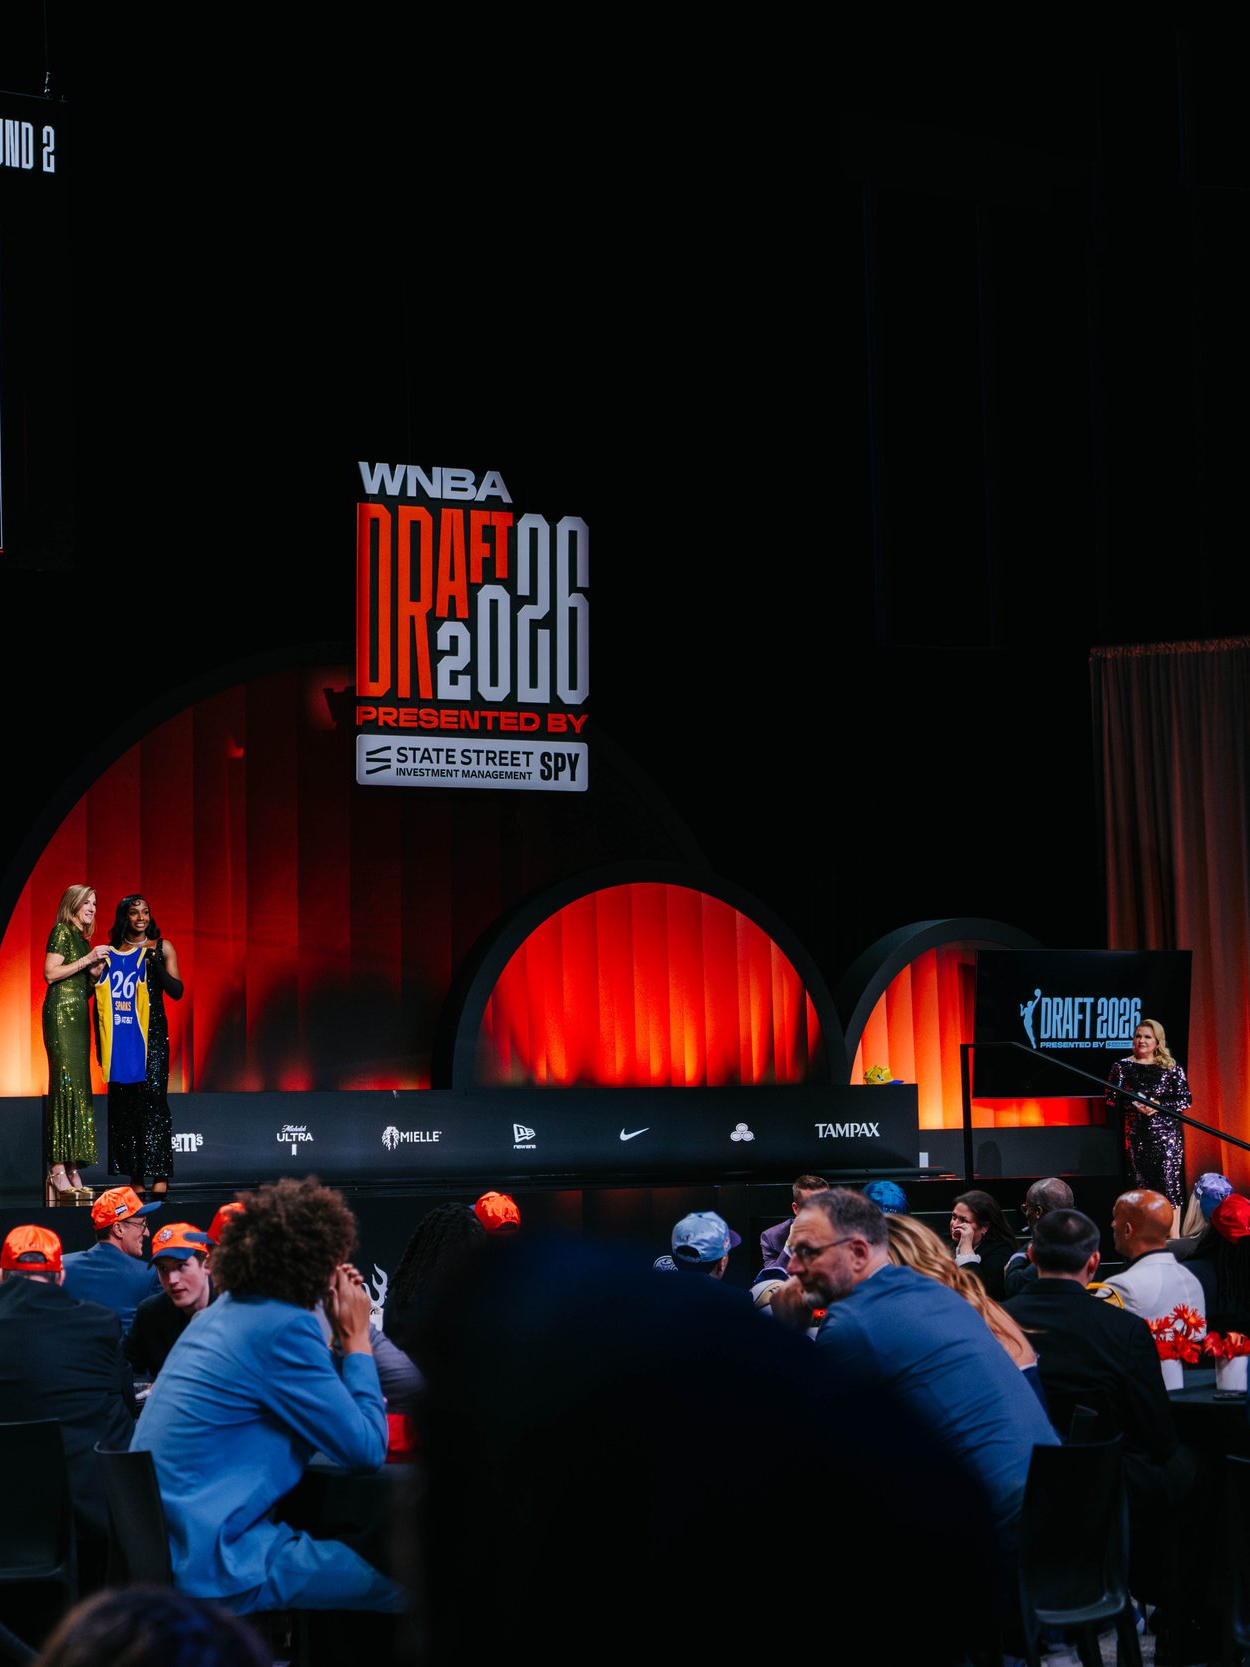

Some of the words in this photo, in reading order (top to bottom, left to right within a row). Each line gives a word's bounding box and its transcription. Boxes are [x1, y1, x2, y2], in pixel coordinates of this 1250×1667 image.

[42, 125, 56, 173] 2
[358, 461, 513, 504] WNBA
[356, 502, 514, 700] DRAFT
[436, 513, 590, 705] 2026
[356, 705, 541, 732] PRESENTED
[547, 713, 589, 734] BY
[396, 746, 457, 765] STATE
[460, 748, 534, 768] STREET
[539, 751, 580, 782] SPY
[396, 767, 460, 779] INVESTMENT
[461, 769, 533, 781] MANAGEMENT
[112, 970, 136, 999] 26
[1040, 997, 1094, 1040] DRAFT
[1096, 997, 1142, 1040] 2026
[1040, 1041, 1091, 1049] PRESENTED
[1092, 1041, 1105, 1049] BY
[276, 1132, 313, 1142] ULTRA
[400, 1131, 440, 1143] MIELLE
[815, 1122, 880, 1138] TAMPAX
